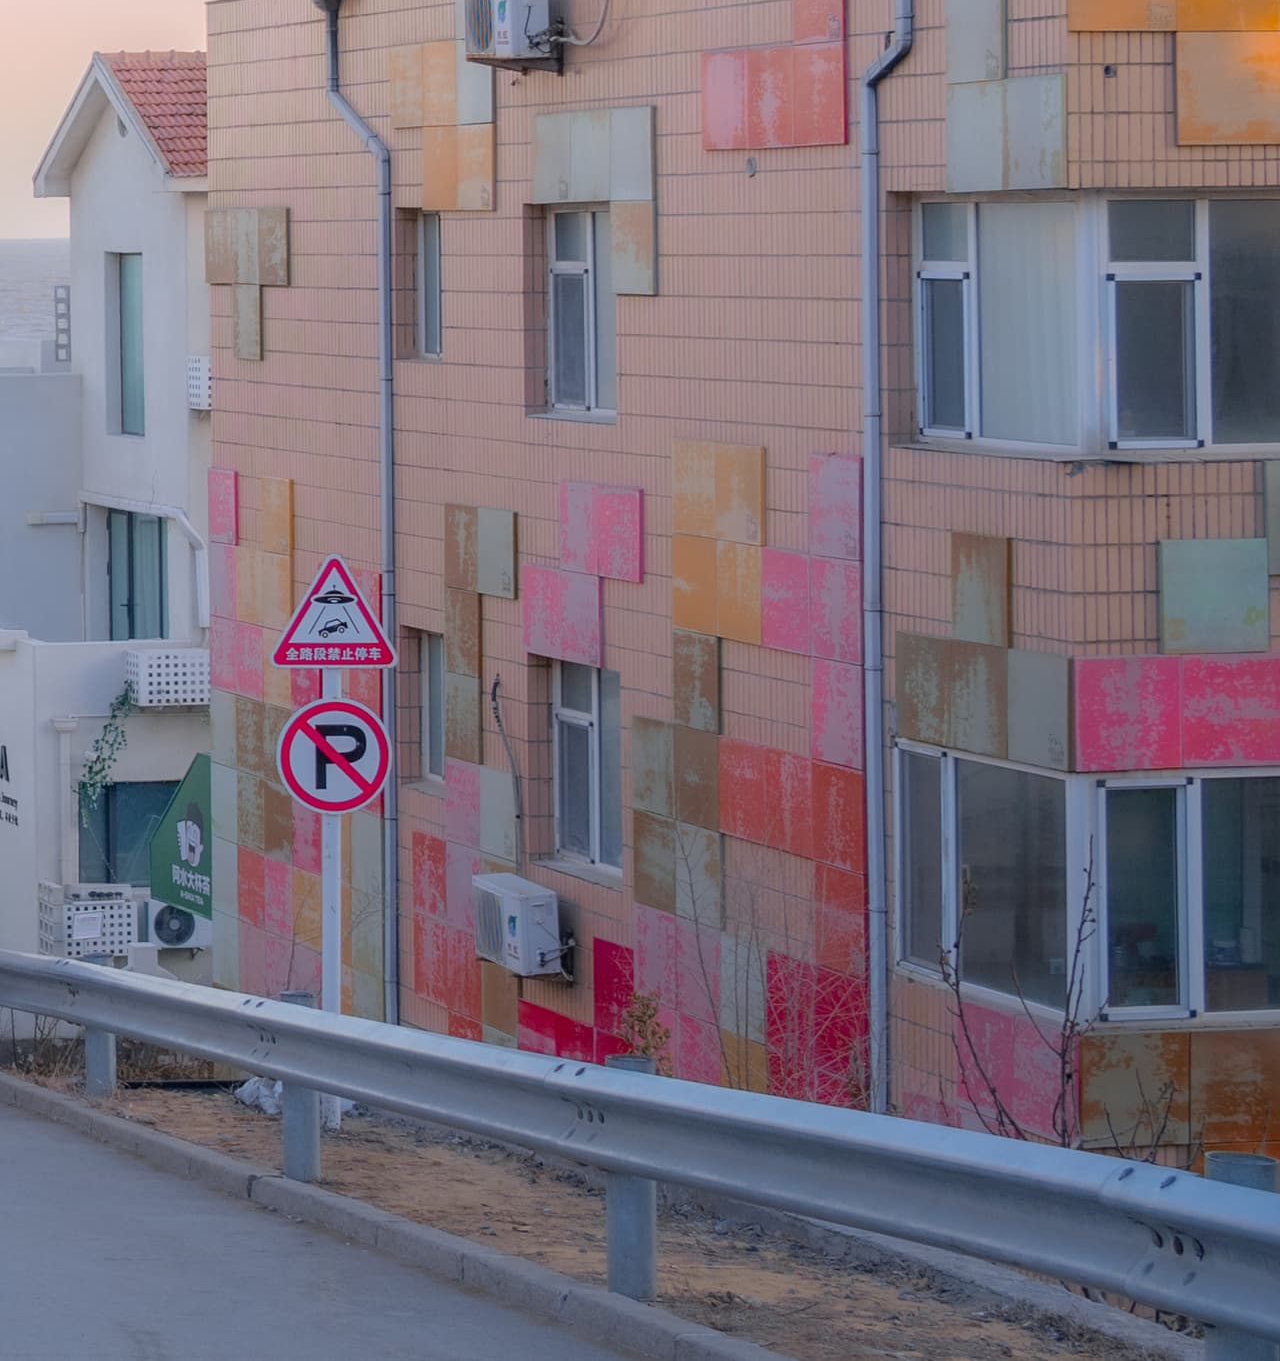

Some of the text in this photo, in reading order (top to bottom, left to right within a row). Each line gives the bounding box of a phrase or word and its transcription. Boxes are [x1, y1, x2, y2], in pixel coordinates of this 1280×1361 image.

[286, 647, 382, 661] 全路段禁止停车
